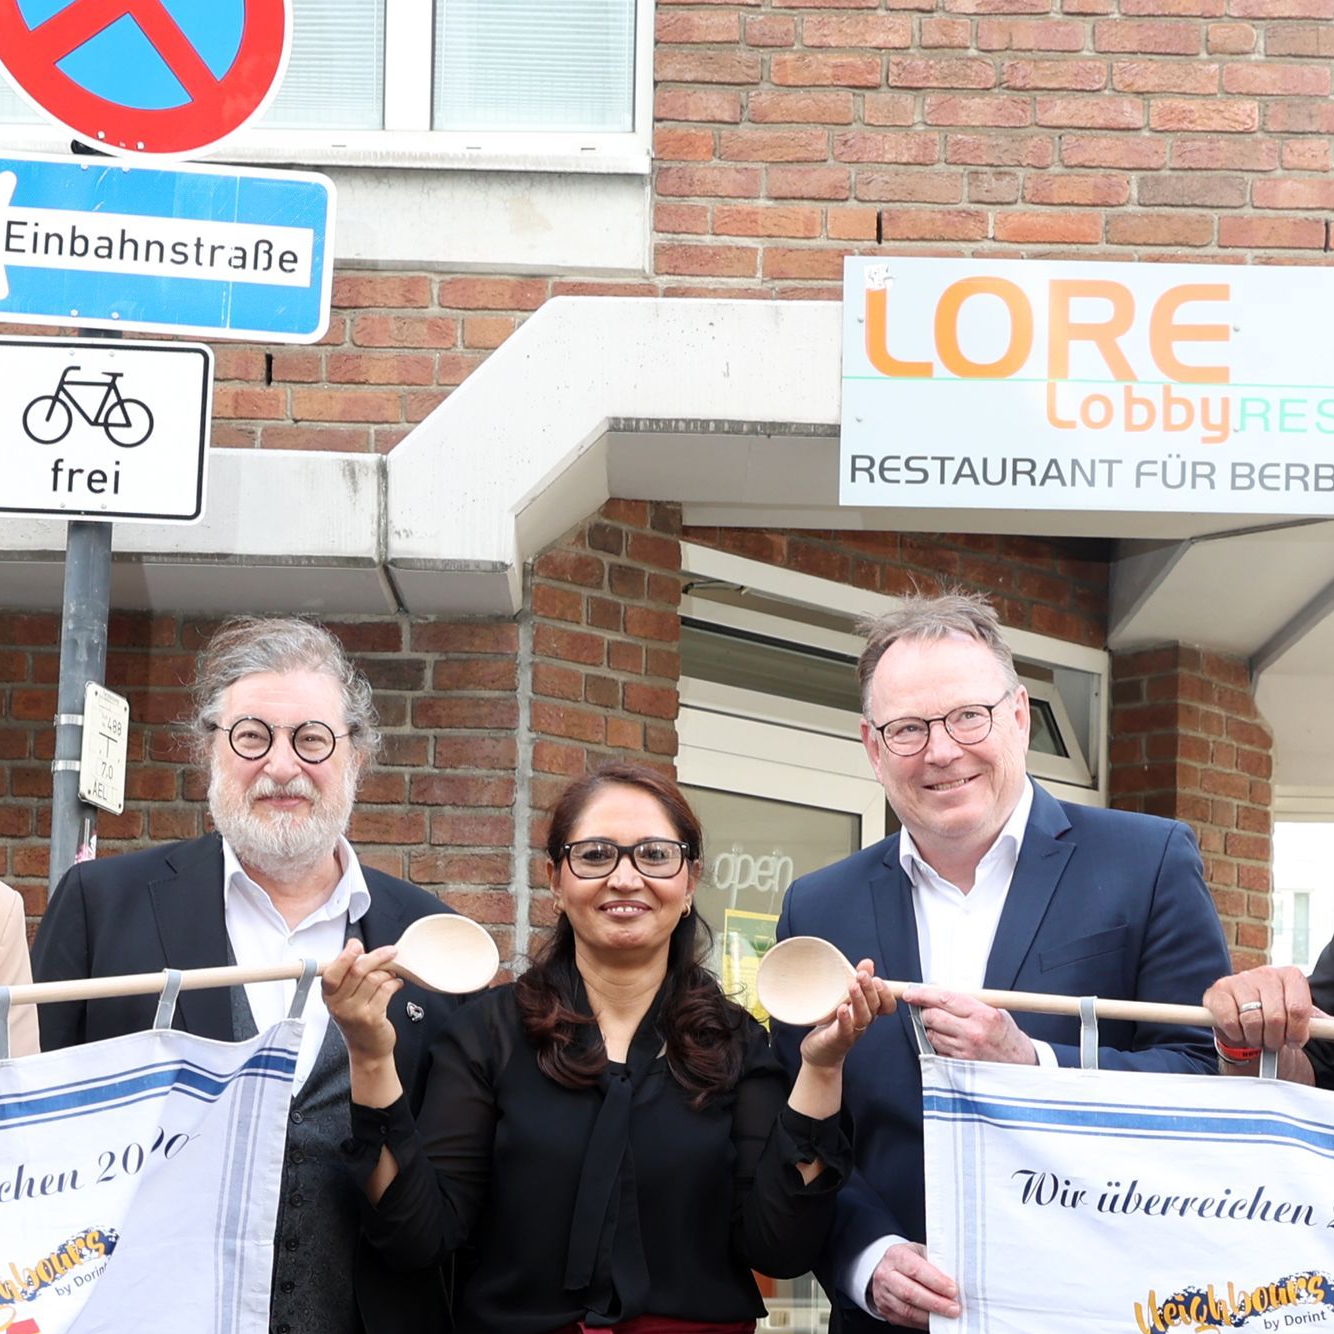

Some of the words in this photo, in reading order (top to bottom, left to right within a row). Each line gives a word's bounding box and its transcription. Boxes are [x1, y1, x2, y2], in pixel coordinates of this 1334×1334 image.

[4, 220, 299, 274] Einbahnstraße
[865, 274, 1231, 384] LORE
[51, 457, 122, 495] frei
[850, 453, 1123, 488] RESTAURANT
[1135, 452, 1217, 491] FÜR
[714, 852, 794, 909] open
[1011, 1168, 1087, 1209] Wir
[1097, 1179, 1317, 1228] überreichen
[54, 1283, 72, 1297] by
[1263, 1317, 1280, 1331] by
[1284, 1309, 1327, 1326] Dorint
